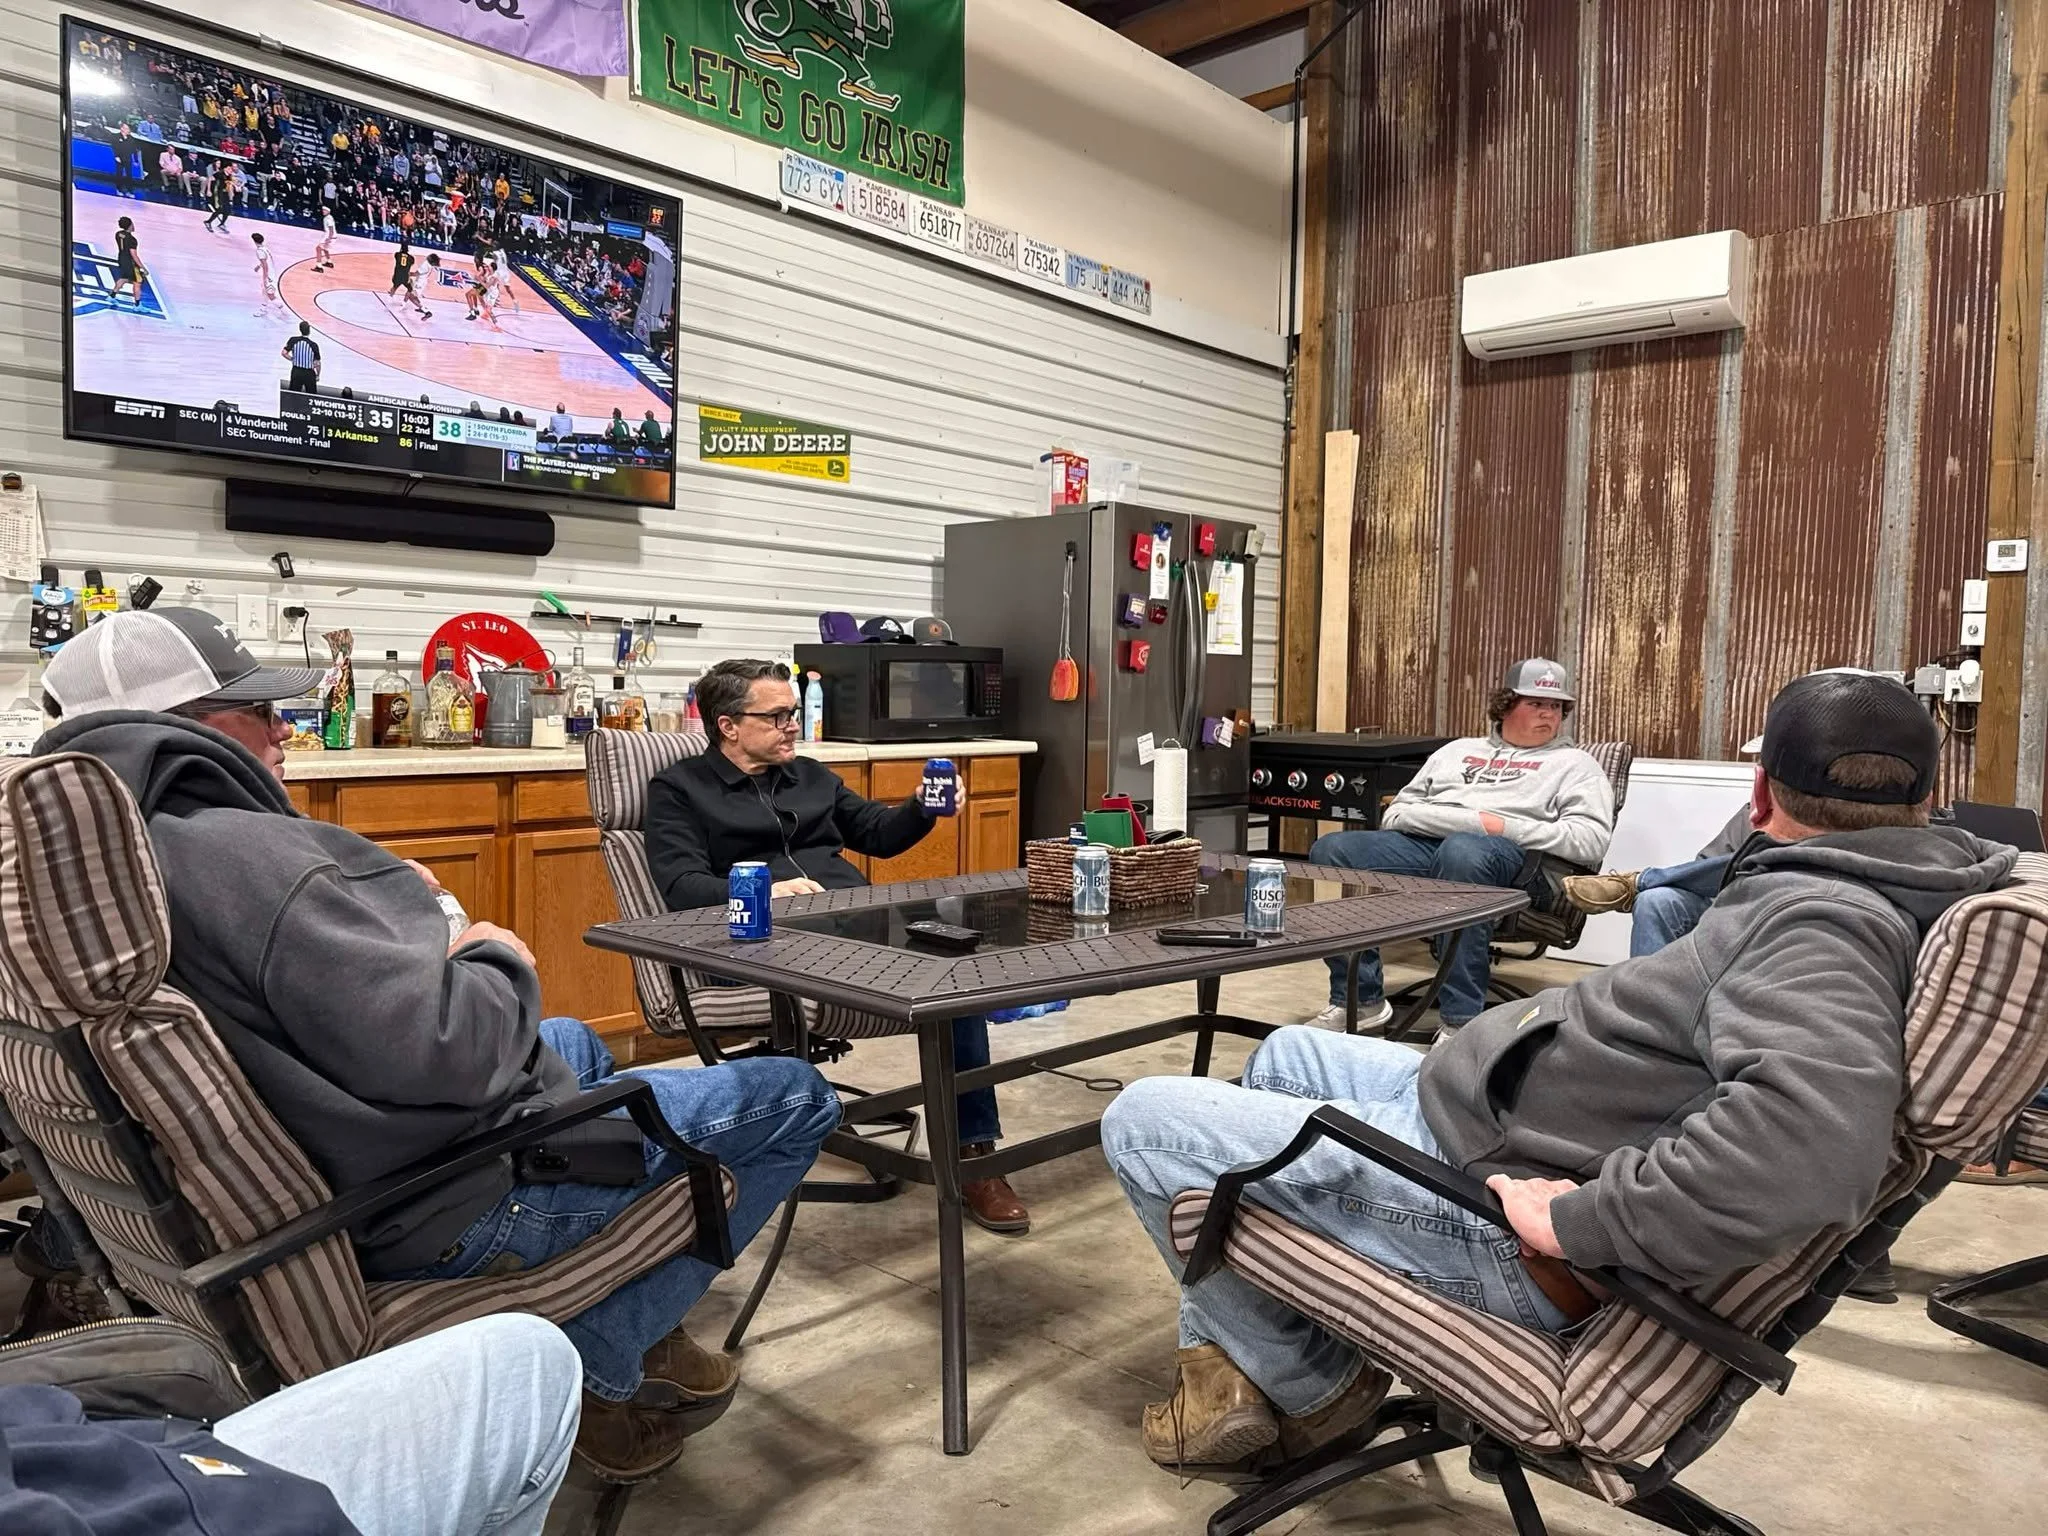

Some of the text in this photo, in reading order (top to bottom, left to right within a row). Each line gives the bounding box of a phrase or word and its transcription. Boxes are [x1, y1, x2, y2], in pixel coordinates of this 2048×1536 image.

[665, 34, 952, 190] LET'S GO IRISH
[797, 157, 834, 177] KANSAS
[787, 164, 811, 193] 773
[820, 177, 844, 206] GYX
[866, 182, 892, 197] KANSAS
[859, 188, 907, 222] 518584
[923, 202, 953, 219] KANSAS
[920, 210, 962, 242] 651877
[978, 222, 1006, 239] KANSAS
[975, 230, 1015, 262] 637264
[1029, 239, 1056, 255] KANSAS
[1023, 247, 1060, 277] 275342
[114, 400, 166, 419] ESPN
[311, 407, 333, 417] 22-10
[313, 399, 346, 410] WICHITA
[367, 394, 462, 415] AMERICAN CHAMPIONSHIP
[179, 409, 217, 424] SEC (M)
[234, 415, 288, 432] Vanderbilt
[368, 409, 394, 429] 35
[402, 413, 430, 426] 16:03
[226, 426, 247, 439] SEC
[249, 428, 302, 445] Tournament
[310, 437, 331, 449] Final
[307, 425, 320, 436] 75
[327, 428, 379, 444] 3 Arkansas
[401, 423, 431, 435] 22 2nd
[438, 420, 461, 438] 38
[477, 424, 499, 433] SOUTH
[499, 427, 528, 437] FLORIDA
[399, 437, 413, 448] 86
[419, 441, 438, 451] Final
[704, 433, 847, 453] JOHN DEERE
[523, 455, 617, 474] THE PLAYERS CHAMPIONSHIP
[484, 620, 508, 634] LEO
[1258, 901, 1281, 910] LIGHT
